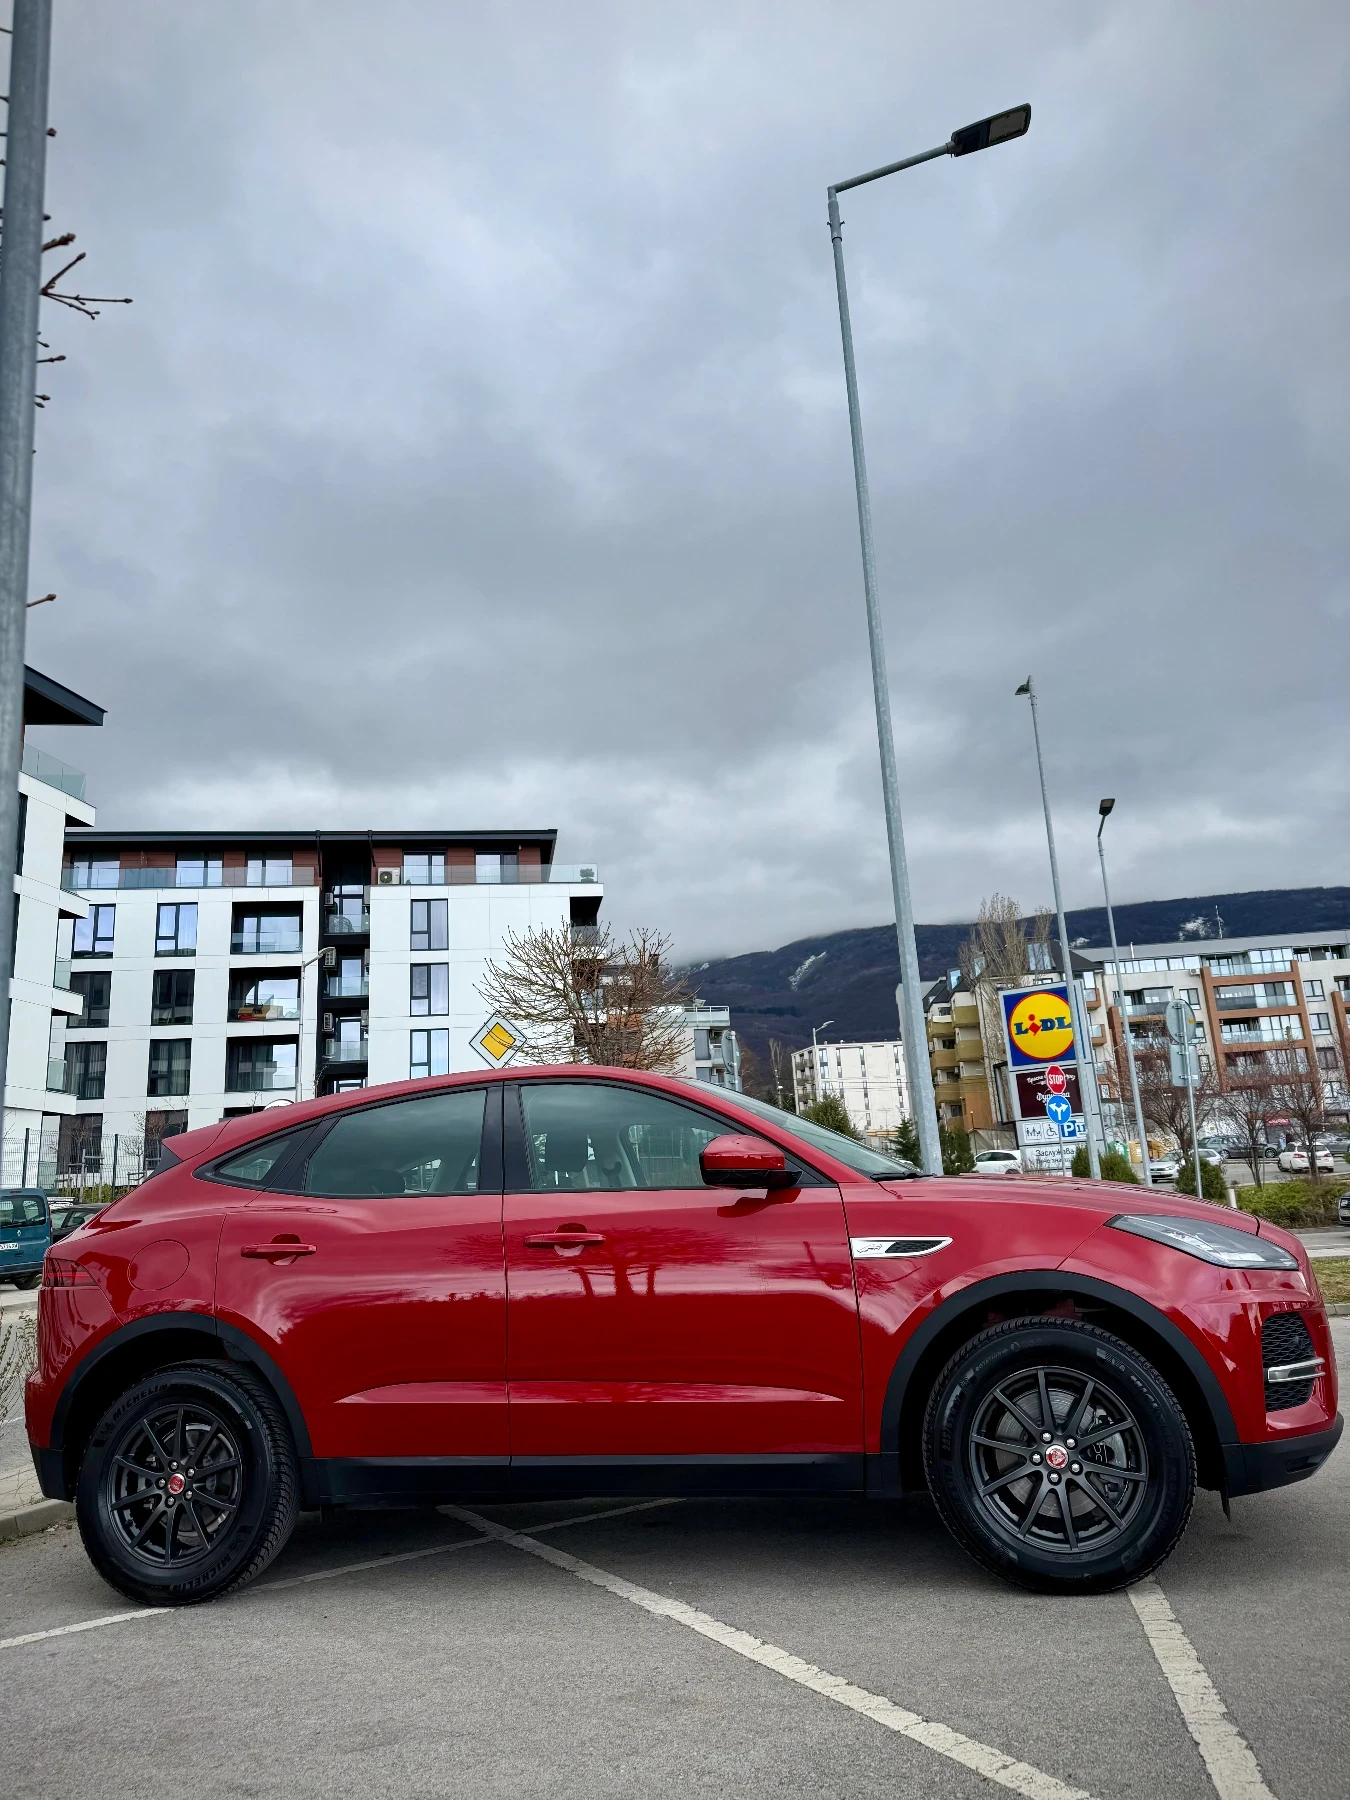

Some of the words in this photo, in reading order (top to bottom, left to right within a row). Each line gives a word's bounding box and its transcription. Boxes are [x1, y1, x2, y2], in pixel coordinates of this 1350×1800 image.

[1048, 1074, 1063, 1085] STOP
[112, 1383, 169, 1422] MICHELIN
[170, 1551, 232, 1594] MICHELIN
